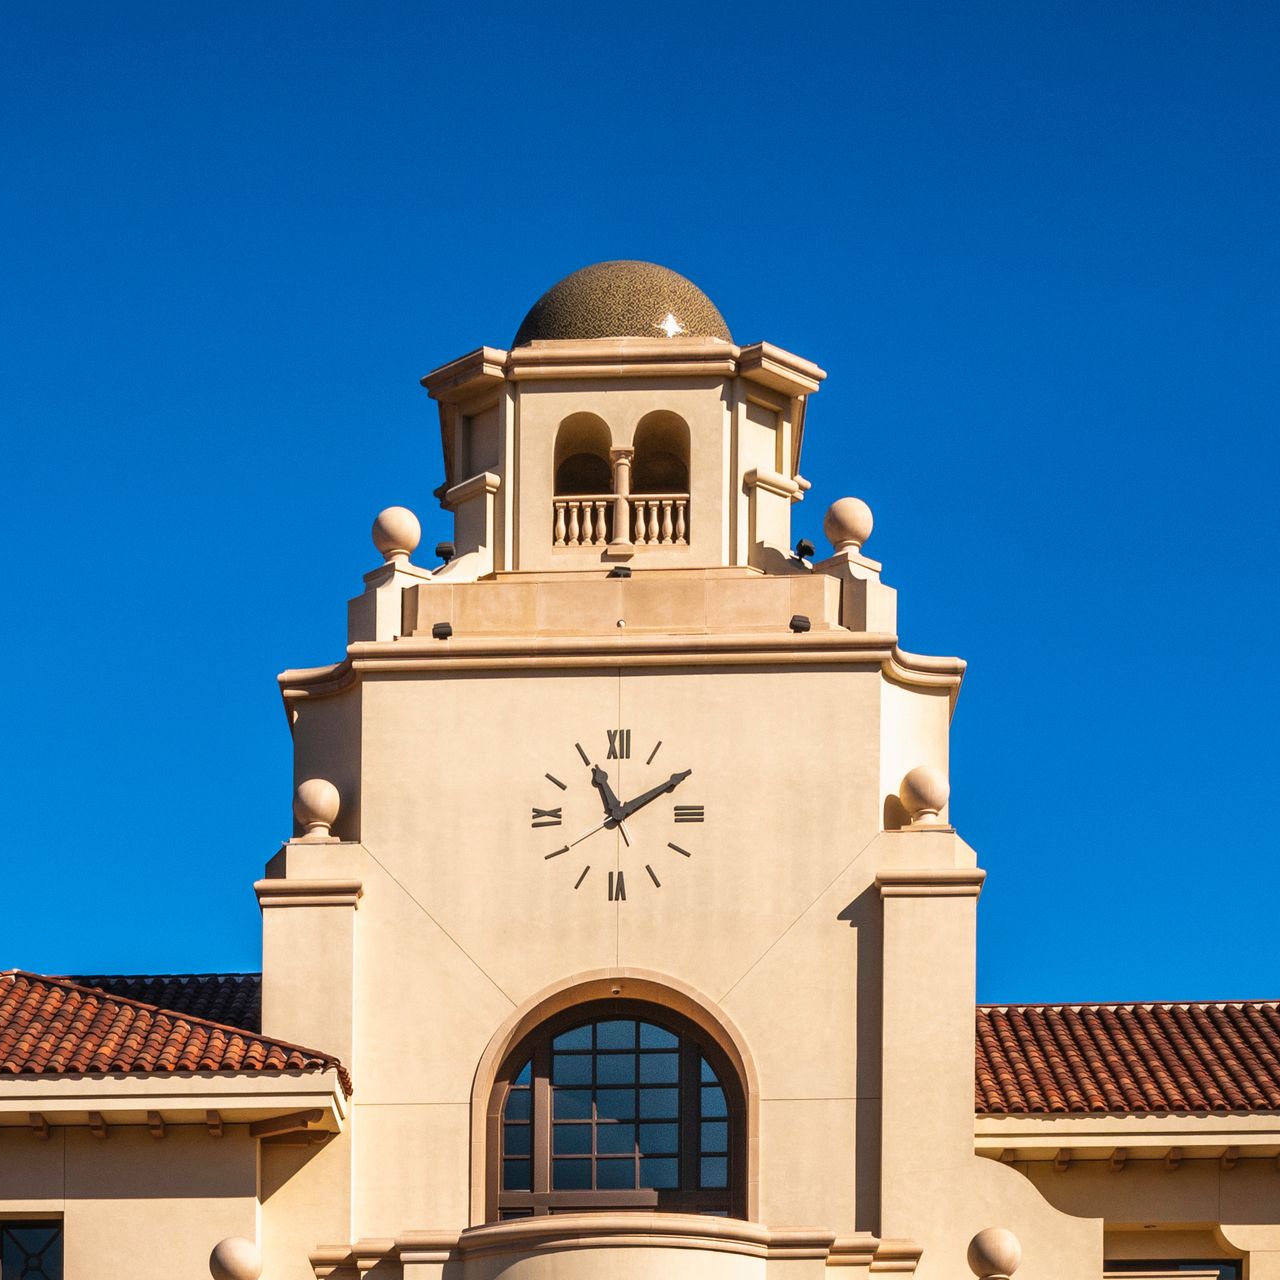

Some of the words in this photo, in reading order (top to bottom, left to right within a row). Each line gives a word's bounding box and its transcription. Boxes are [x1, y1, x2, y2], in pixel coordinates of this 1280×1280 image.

[606, 729, 631, 760] XII
[673, 805, 705, 823] III
[608, 871, 627, 902] VI
